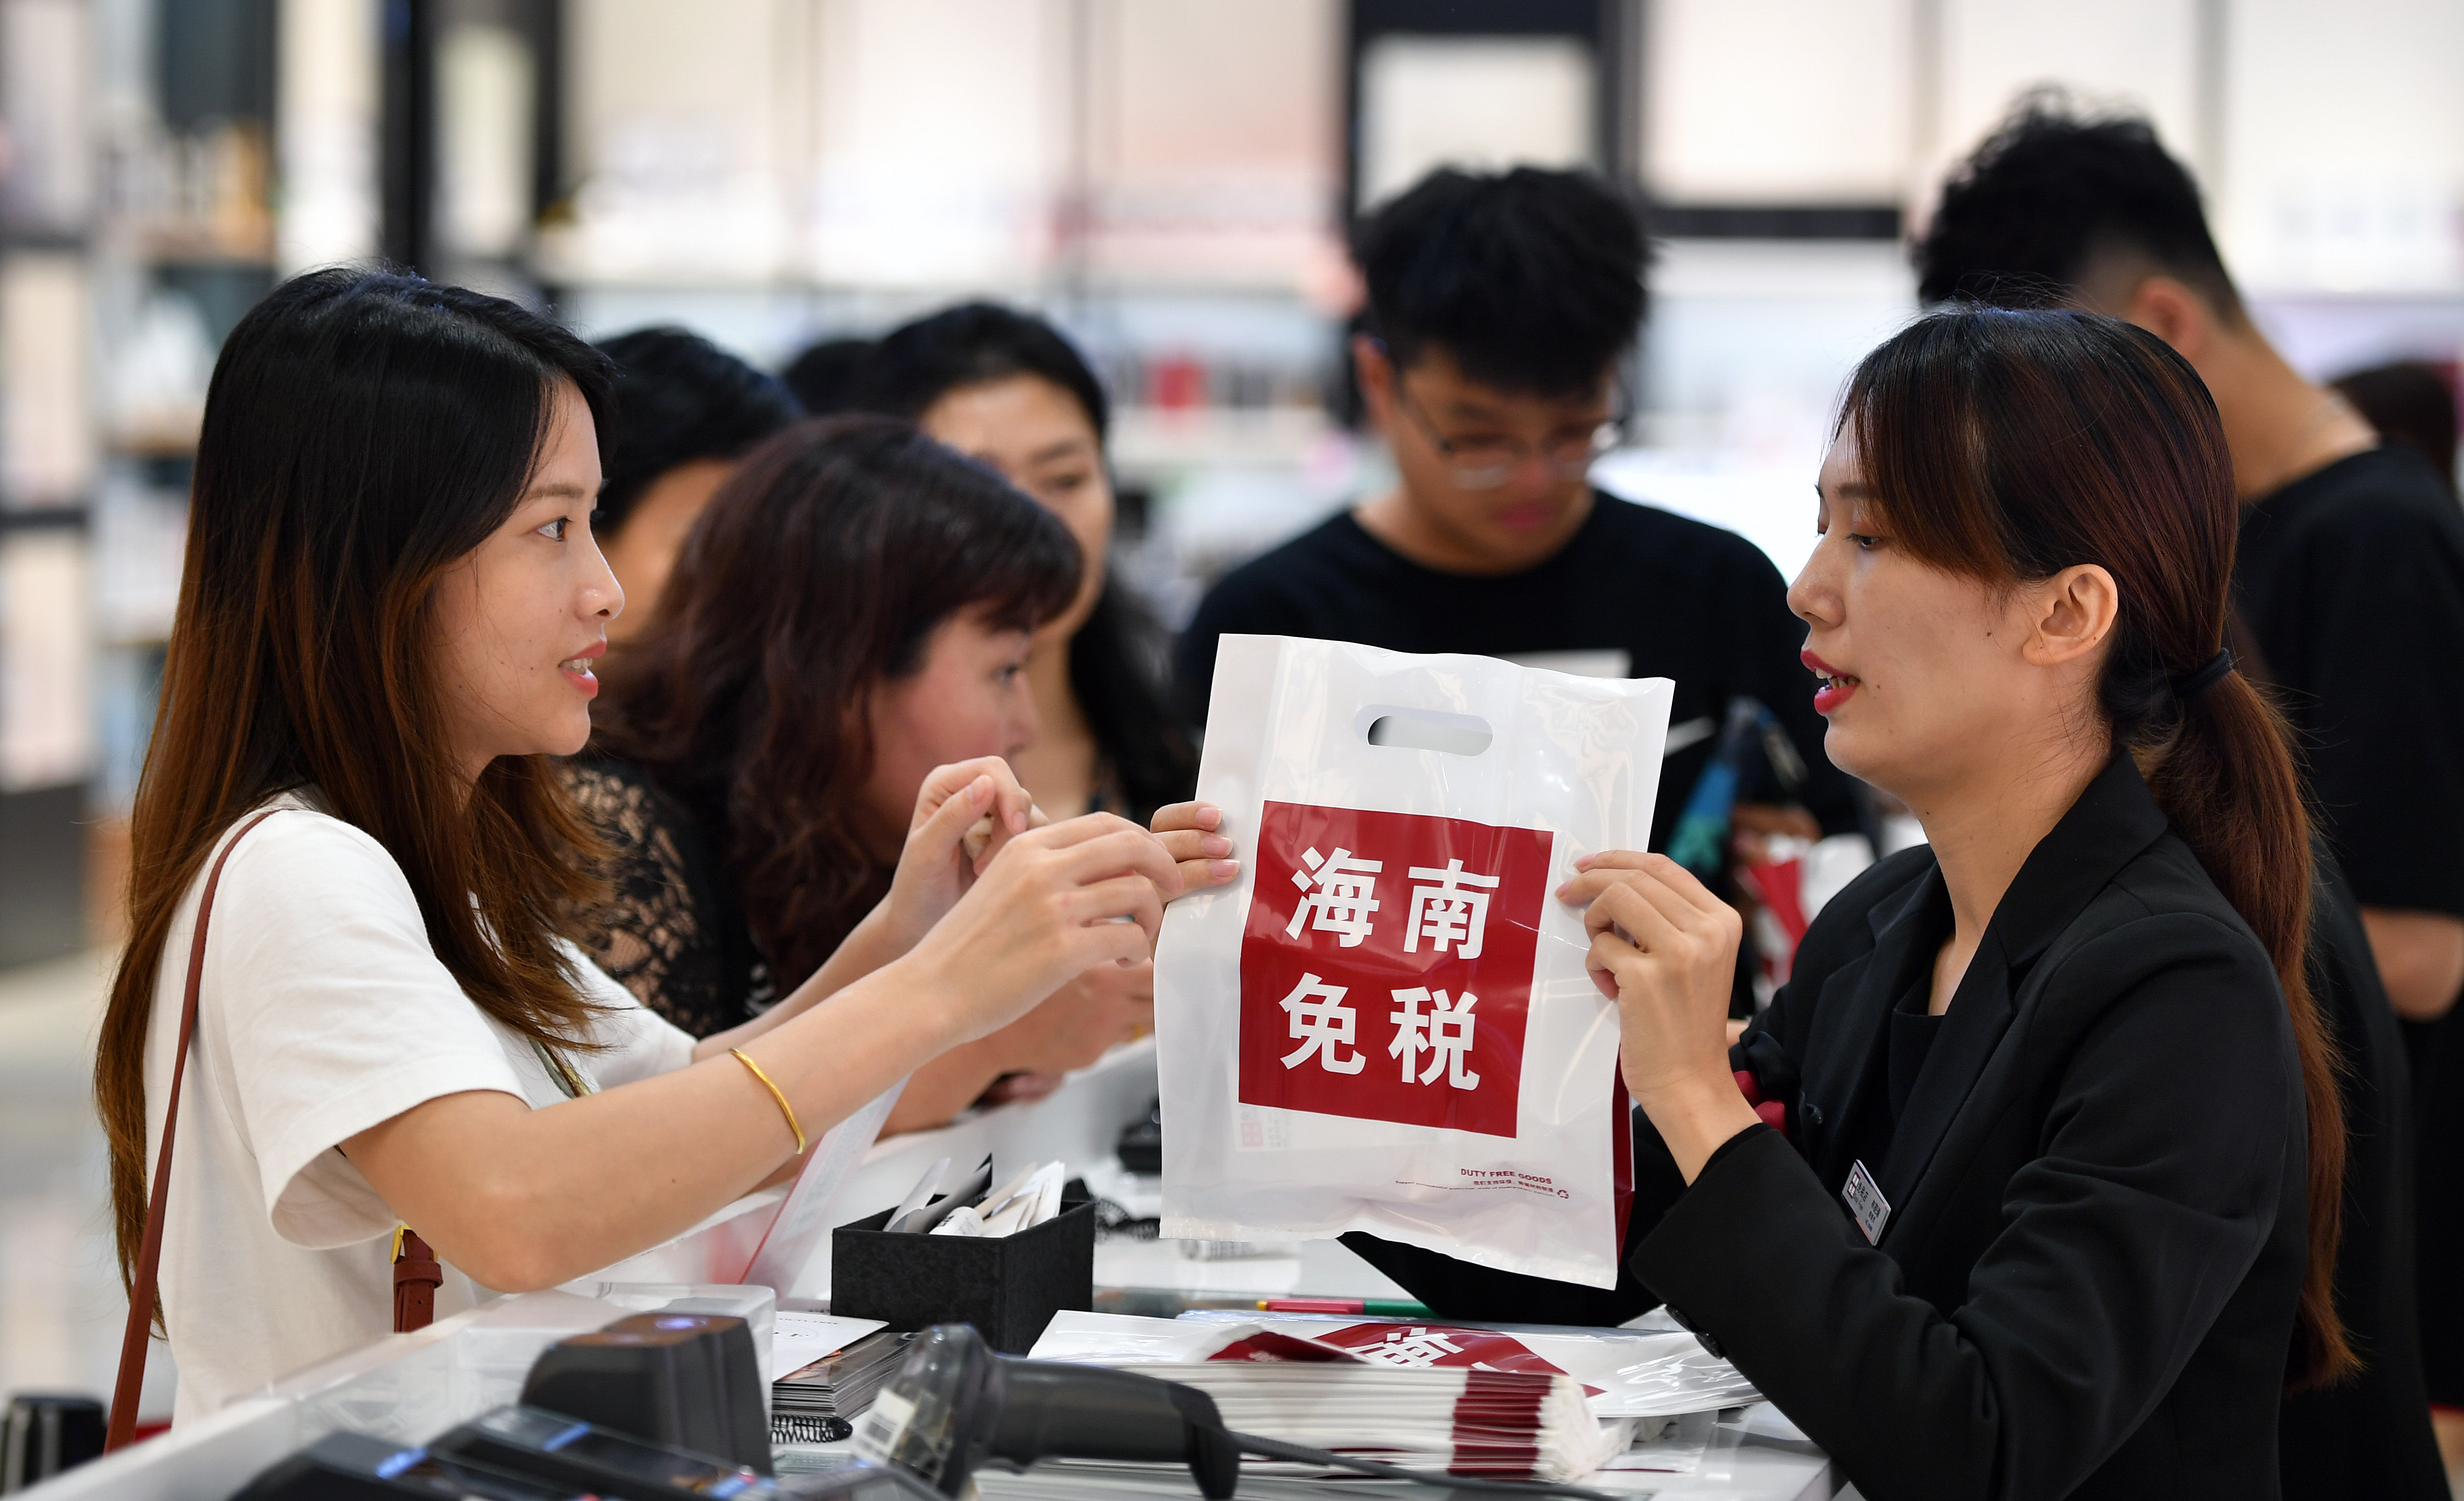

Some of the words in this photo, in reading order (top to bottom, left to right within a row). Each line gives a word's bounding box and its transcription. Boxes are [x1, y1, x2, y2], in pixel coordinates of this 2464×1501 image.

[1285, 847, 1500, 959] 海南
[1279, 973, 1480, 1091] 免税
[1460, 1168, 1486, 1177] DUTY
[1518, 1173, 1552, 1184] GOODS
